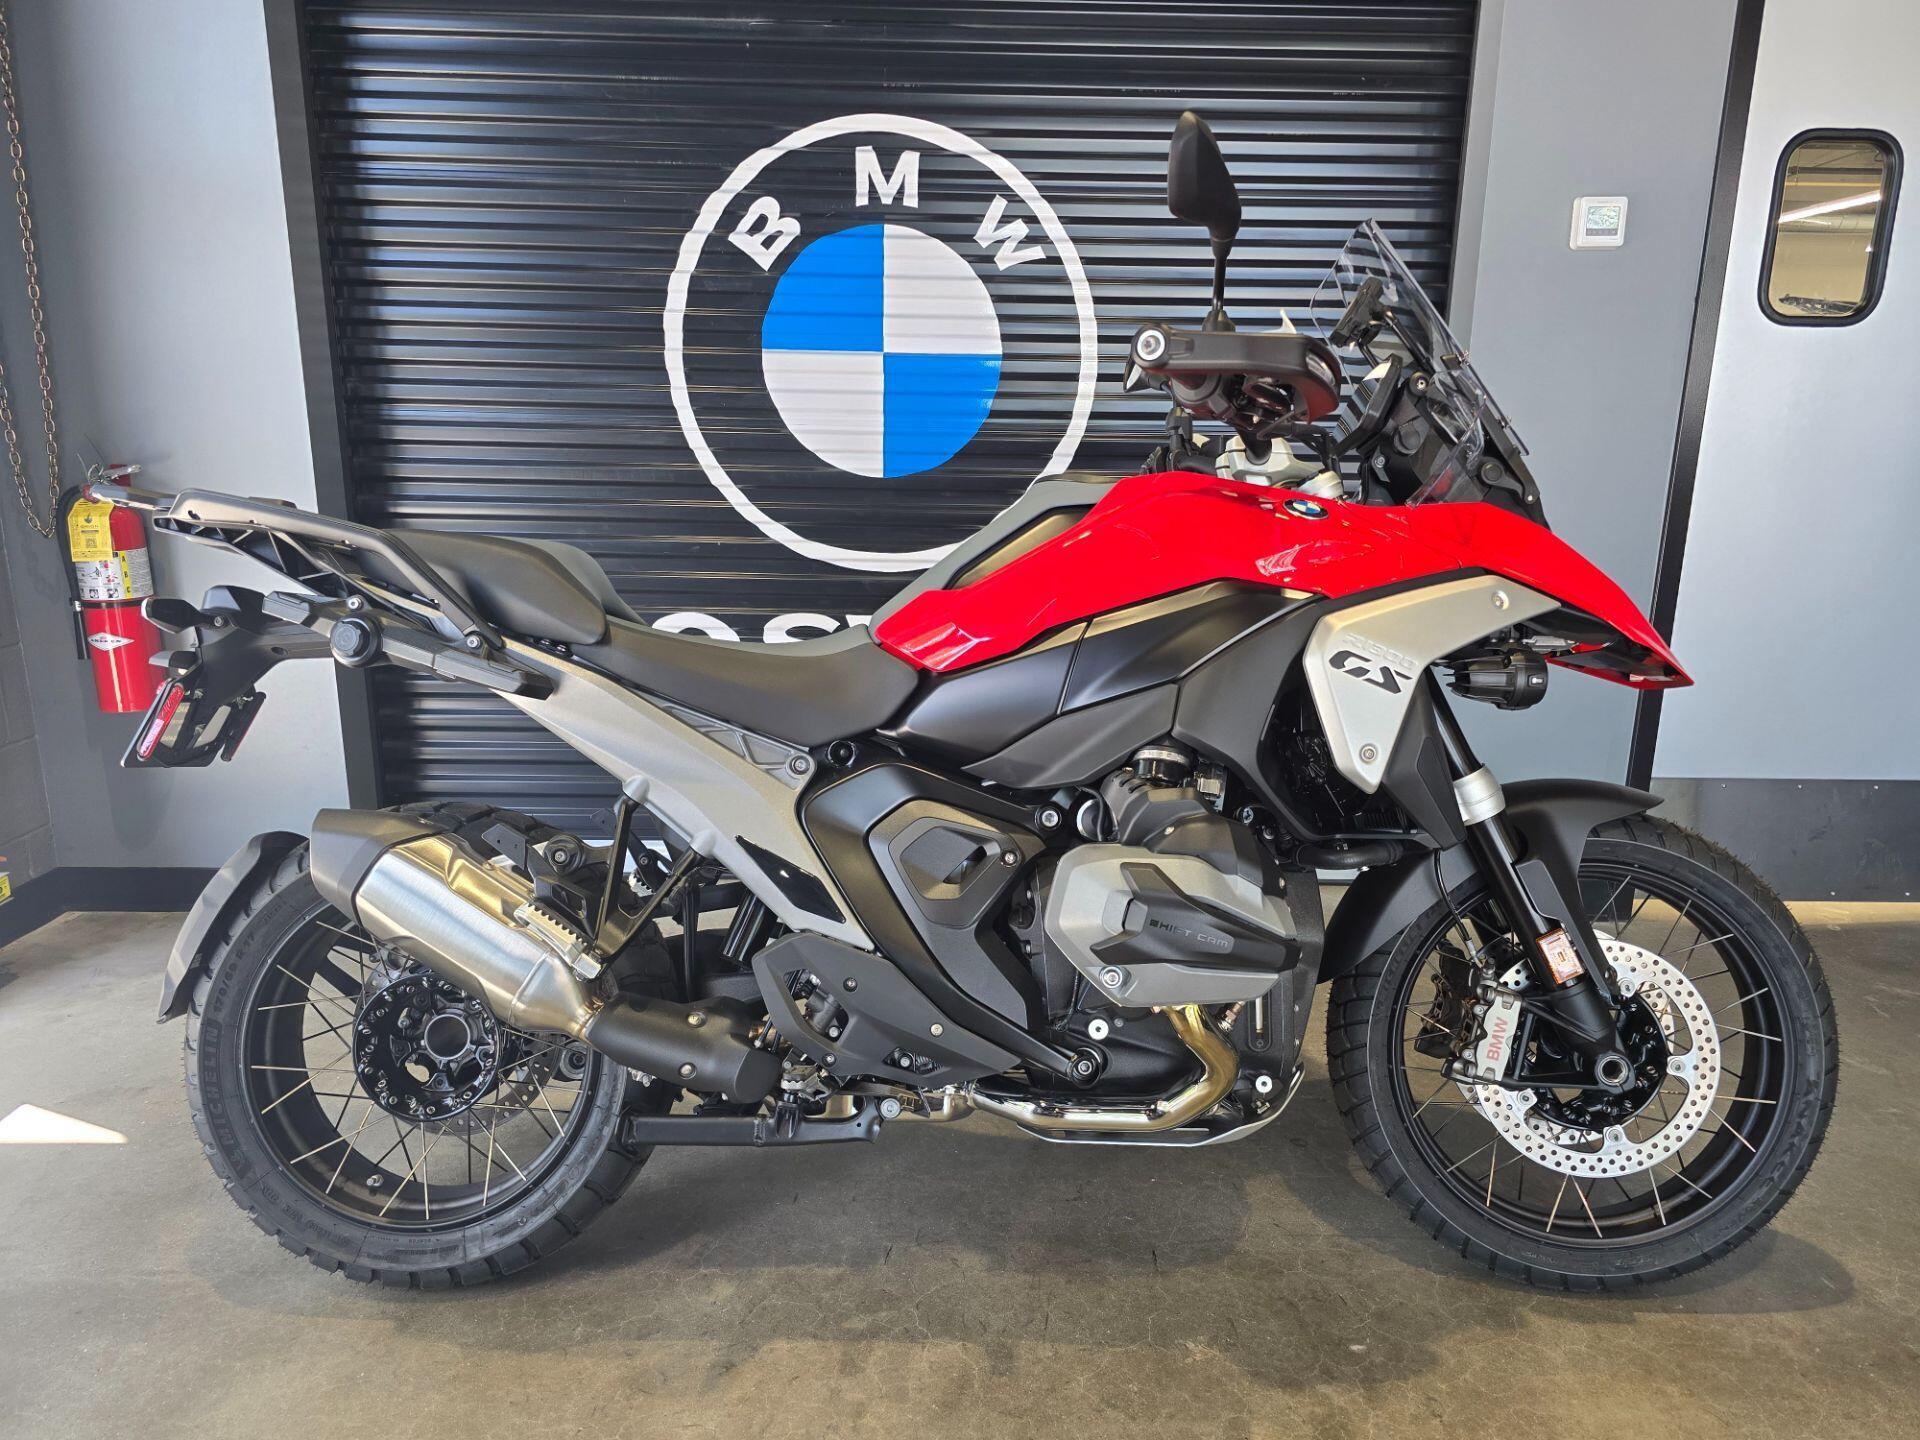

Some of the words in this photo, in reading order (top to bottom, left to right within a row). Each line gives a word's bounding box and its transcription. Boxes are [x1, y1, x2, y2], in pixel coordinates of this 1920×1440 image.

[728, 146, 1047, 272] BMW
[1329, 649, 1413, 694] GS
[1149, 918, 1192, 937] SHIFT
[1486, 1017, 1509, 1062] BMW
[204, 1027, 235, 1146] MICHELIN
